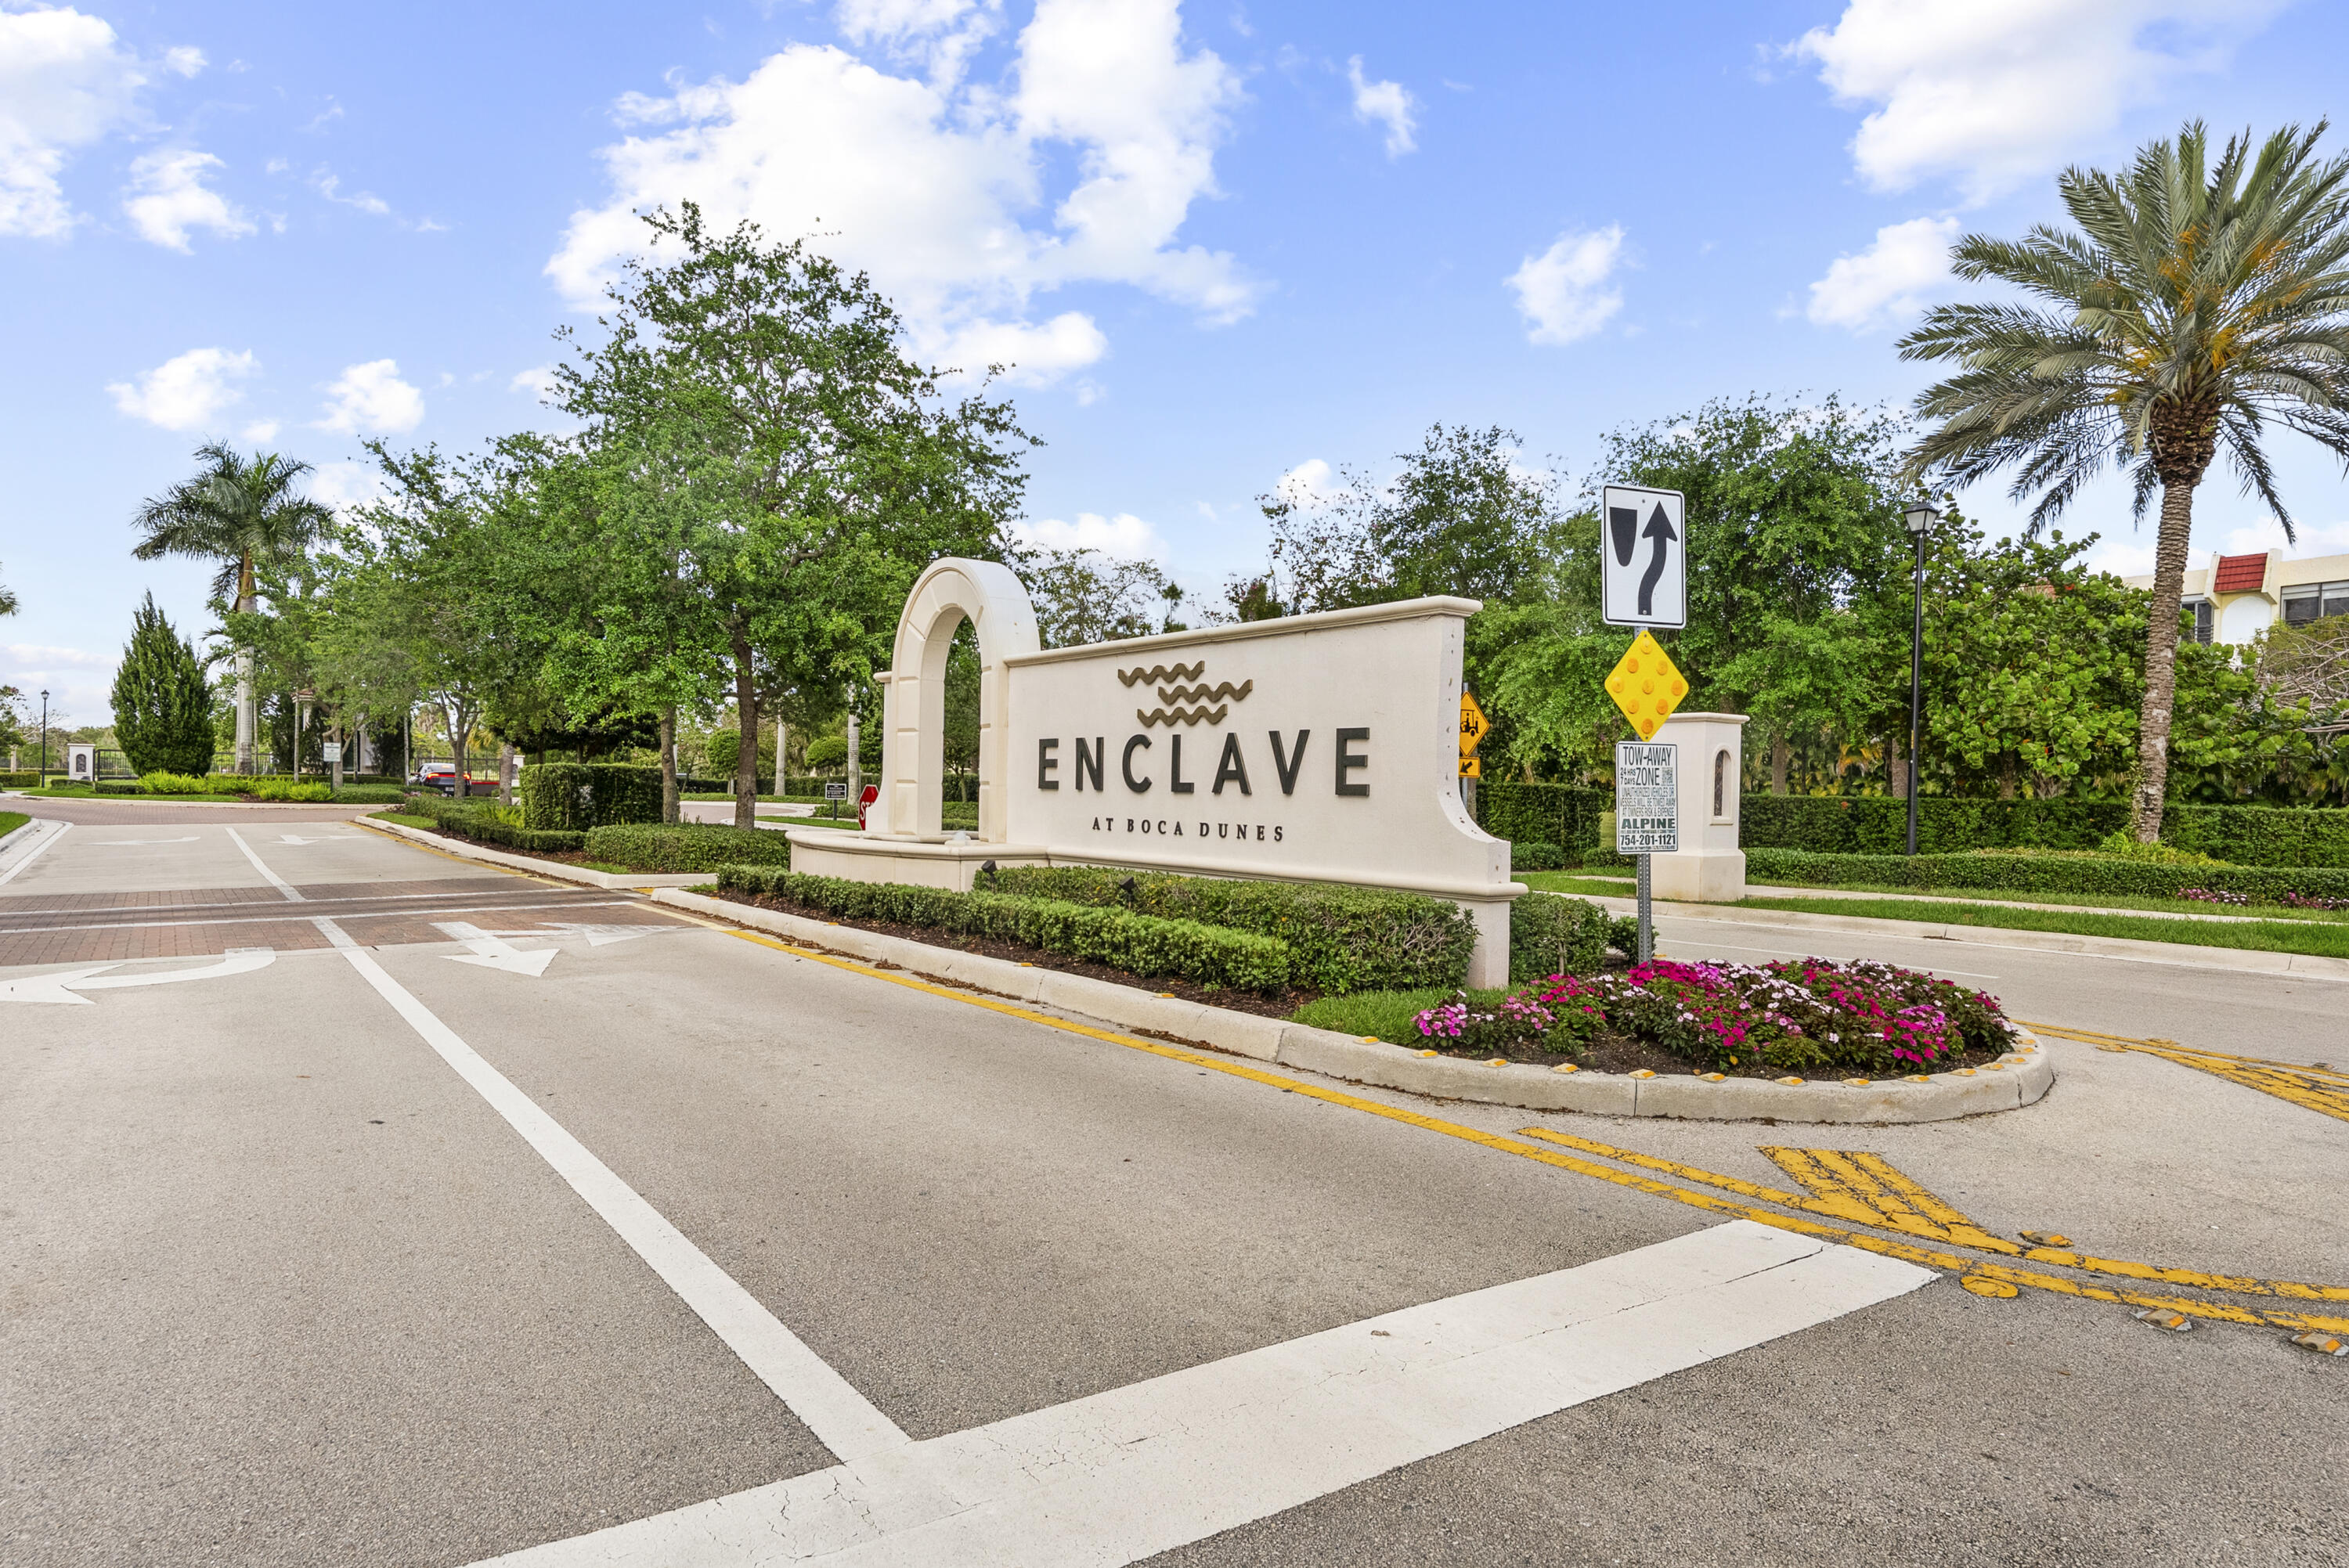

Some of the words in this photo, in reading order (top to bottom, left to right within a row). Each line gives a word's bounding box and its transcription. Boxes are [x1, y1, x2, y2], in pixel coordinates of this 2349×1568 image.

[1037, 726, 1370, 796] ENCLAVE
[1623, 746, 1672, 766] TOW-AWAY
[1620, 767, 1626, 776] 24
[1636, 767, 1660, 786] ZONE
[1621, 777, 1624, 785] 7
[1622, 787, 1650, 797] UNAUTHORIZED
[1651, 787, 1669, 797] VEHICLES
[1620, 798, 1636, 807] VESSELS
[1636, 798, 1646, 807] WILL
[1647, 798, 1652, 807] BE
[1653, 798, 1665, 807] TOWED
[1665, 798, 1676, 807] AWAY
[1622, 807, 1627, 817] AT
[1644, 807, 1653, 816] RISK
[1654, 807, 1657, 816] &
[1658, 807, 1674, 816] EXPENSE
[1092, 816, 1114, 831] AT
[1127, 818, 1184, 836] BOCA
[1199, 822, 1284, 842] DUNES
[1622, 818, 1676, 829] ALPINE
[1620, 834, 1676, 845] 754-201-1121
